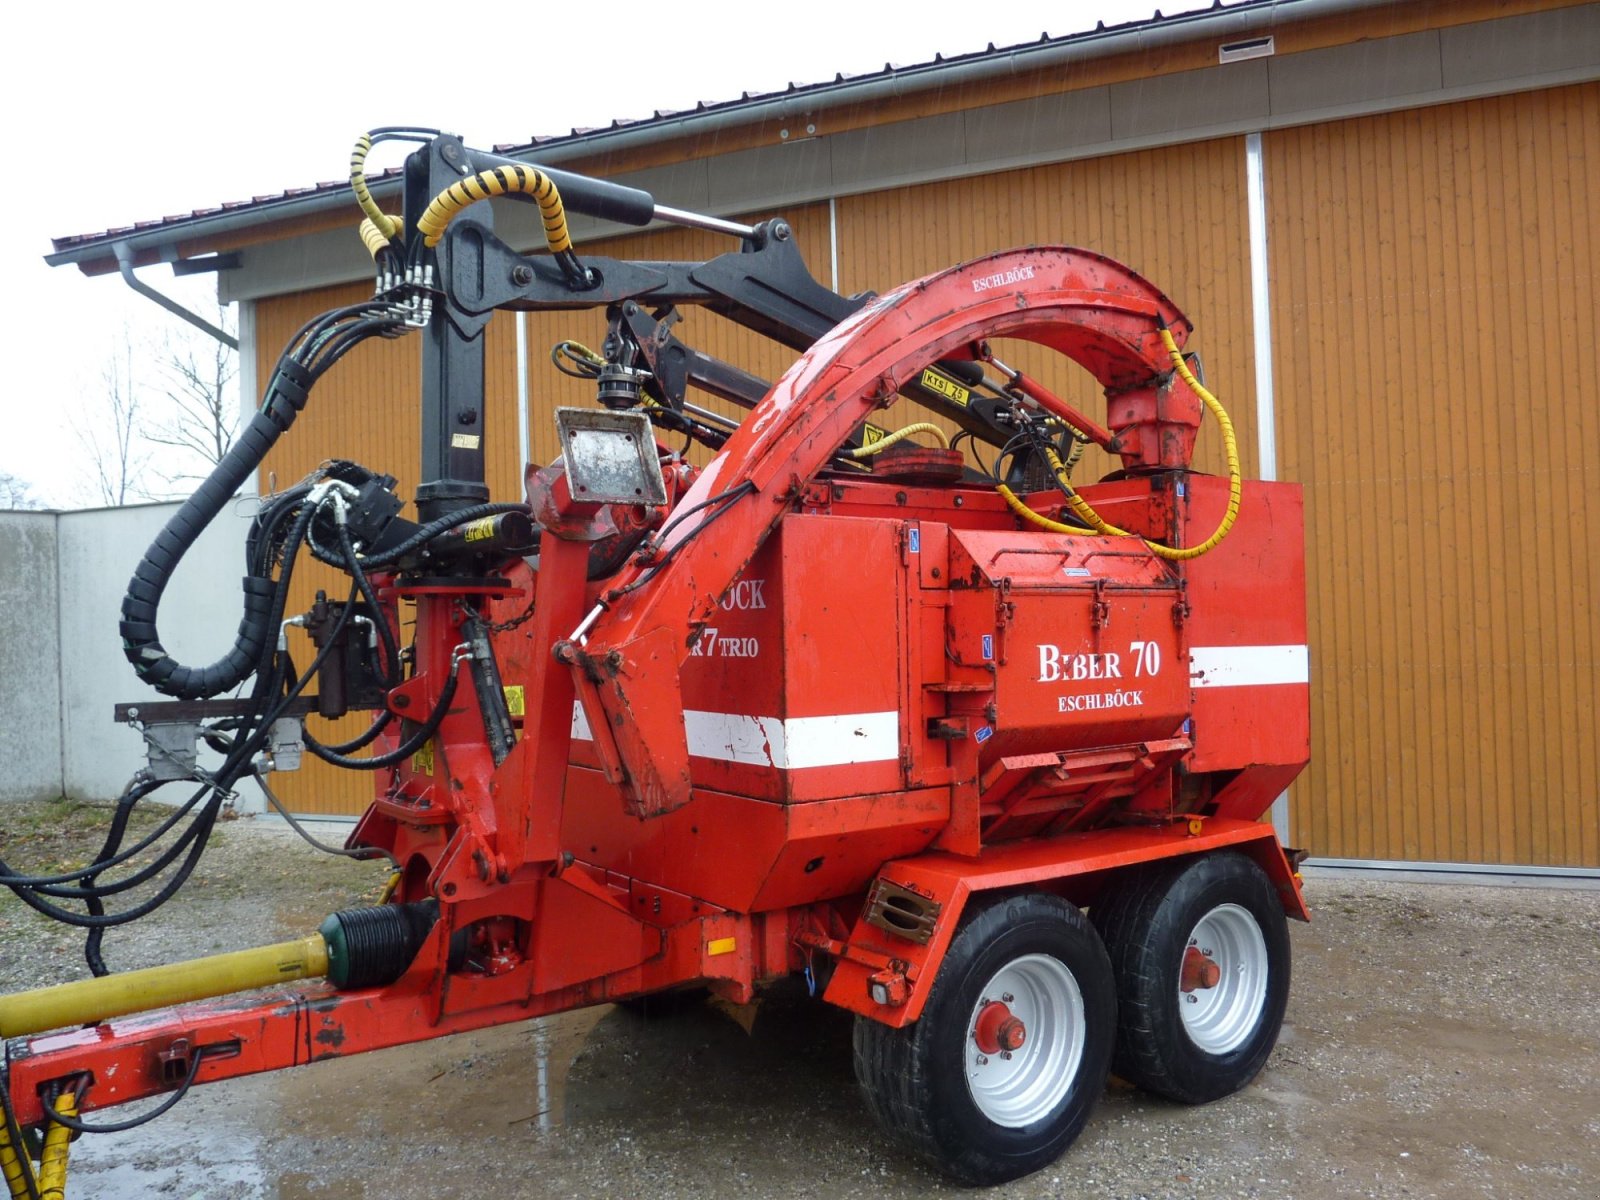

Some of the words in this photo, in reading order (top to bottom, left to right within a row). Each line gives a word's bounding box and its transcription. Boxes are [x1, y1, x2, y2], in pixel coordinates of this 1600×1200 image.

[972, 266, 1035, 293] ESCHLBÖCK
[703, 628, 718, 657] 7
[718, 637, 759, 657] TRIO
[1036, 644, 1122, 682] BIBER
[1129, 641, 1160, 677] 70
[1058, 688, 1143, 713] ESCHLBÖCK
